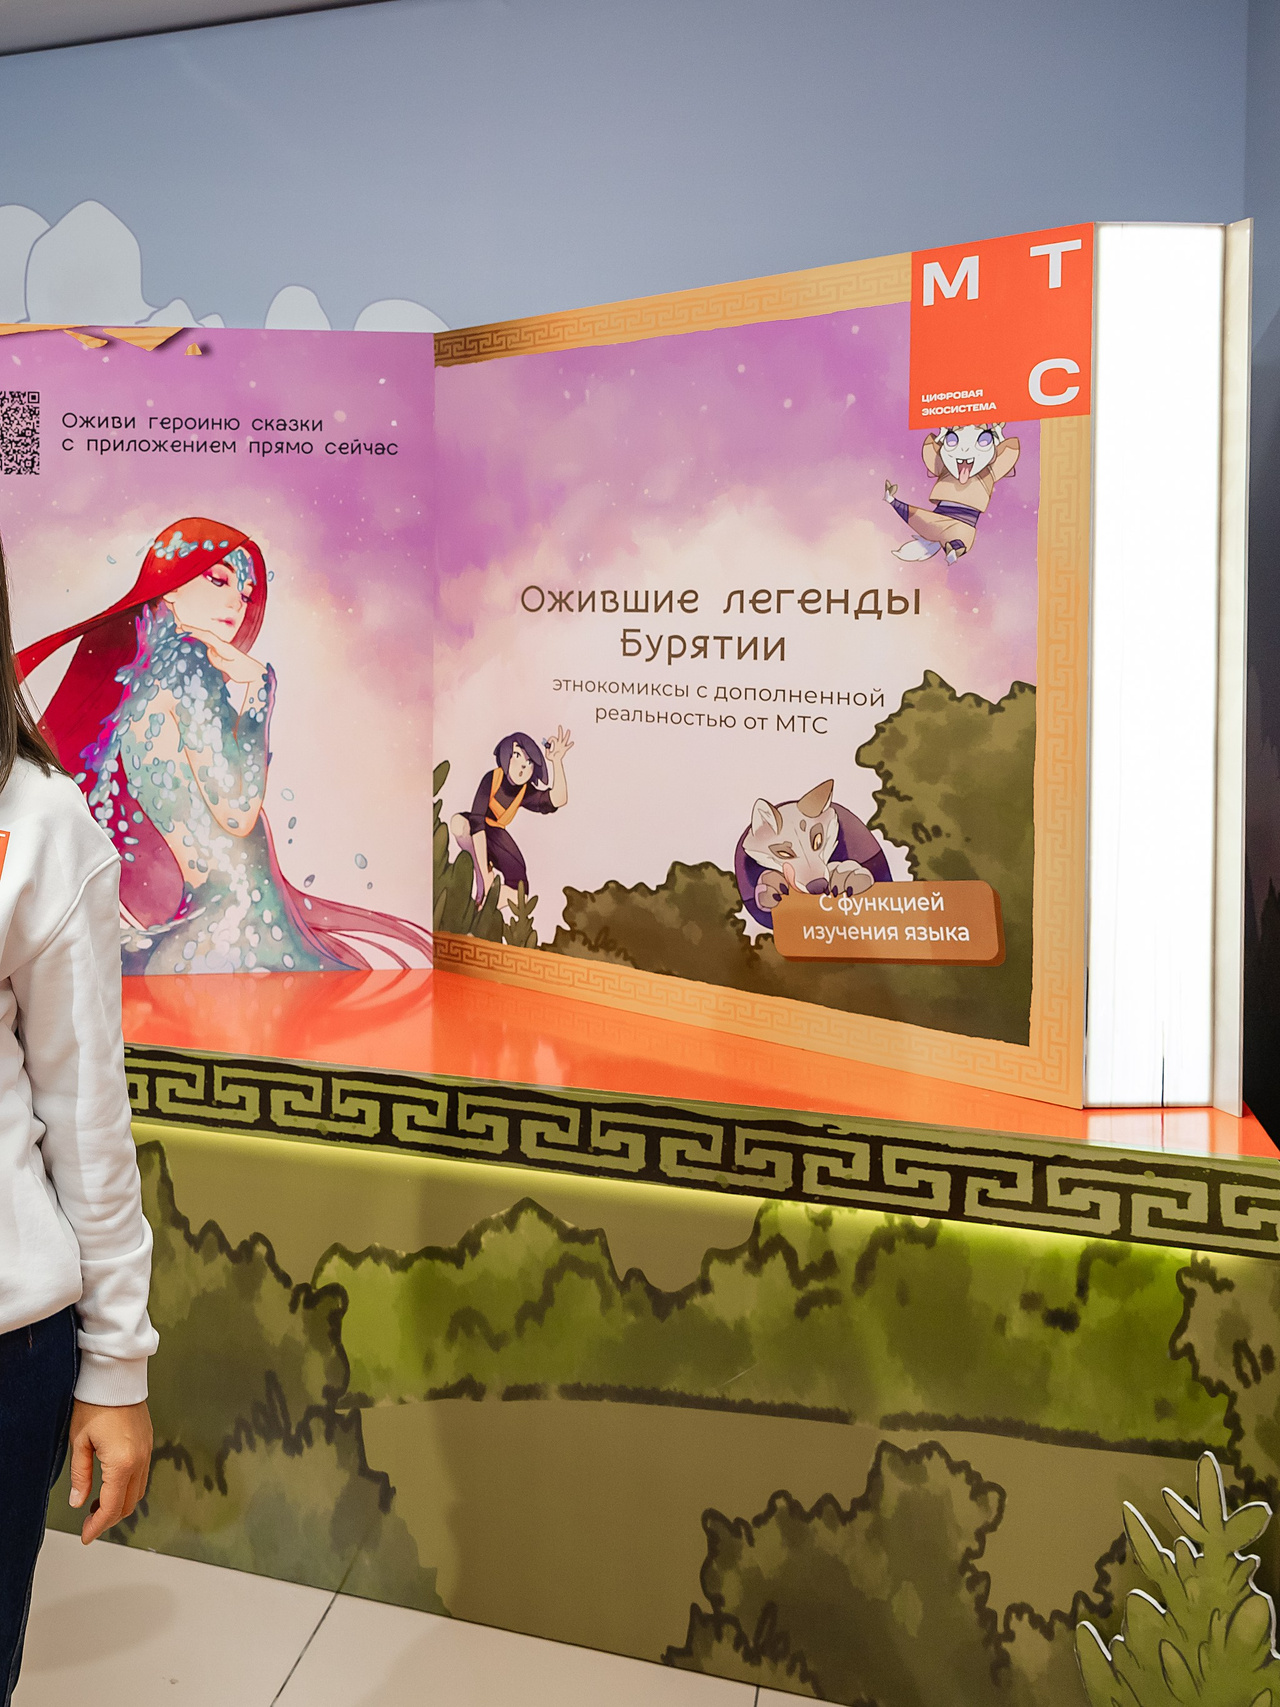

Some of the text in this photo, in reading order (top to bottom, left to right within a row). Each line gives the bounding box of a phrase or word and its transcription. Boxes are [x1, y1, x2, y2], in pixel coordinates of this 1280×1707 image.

[921, 389, 983, 403] ЦИФРОВАЯ
[921, 402, 997, 416] ЭКОСИСТЕМА
[62, 412, 323, 434] Оживи героиню сказки
[62, 437, 399, 456] с приложением прямо сейчас
[520, 585, 921, 620] Ожившие легенды
[621, 628, 786, 665] Бурятии
[552, 678, 885, 707] этнокомиксы с дополненной
[595, 705, 828, 735] реальностью от МТС
[837, 892, 945, 916] функцией
[803, 925, 970, 944] изучения языка
